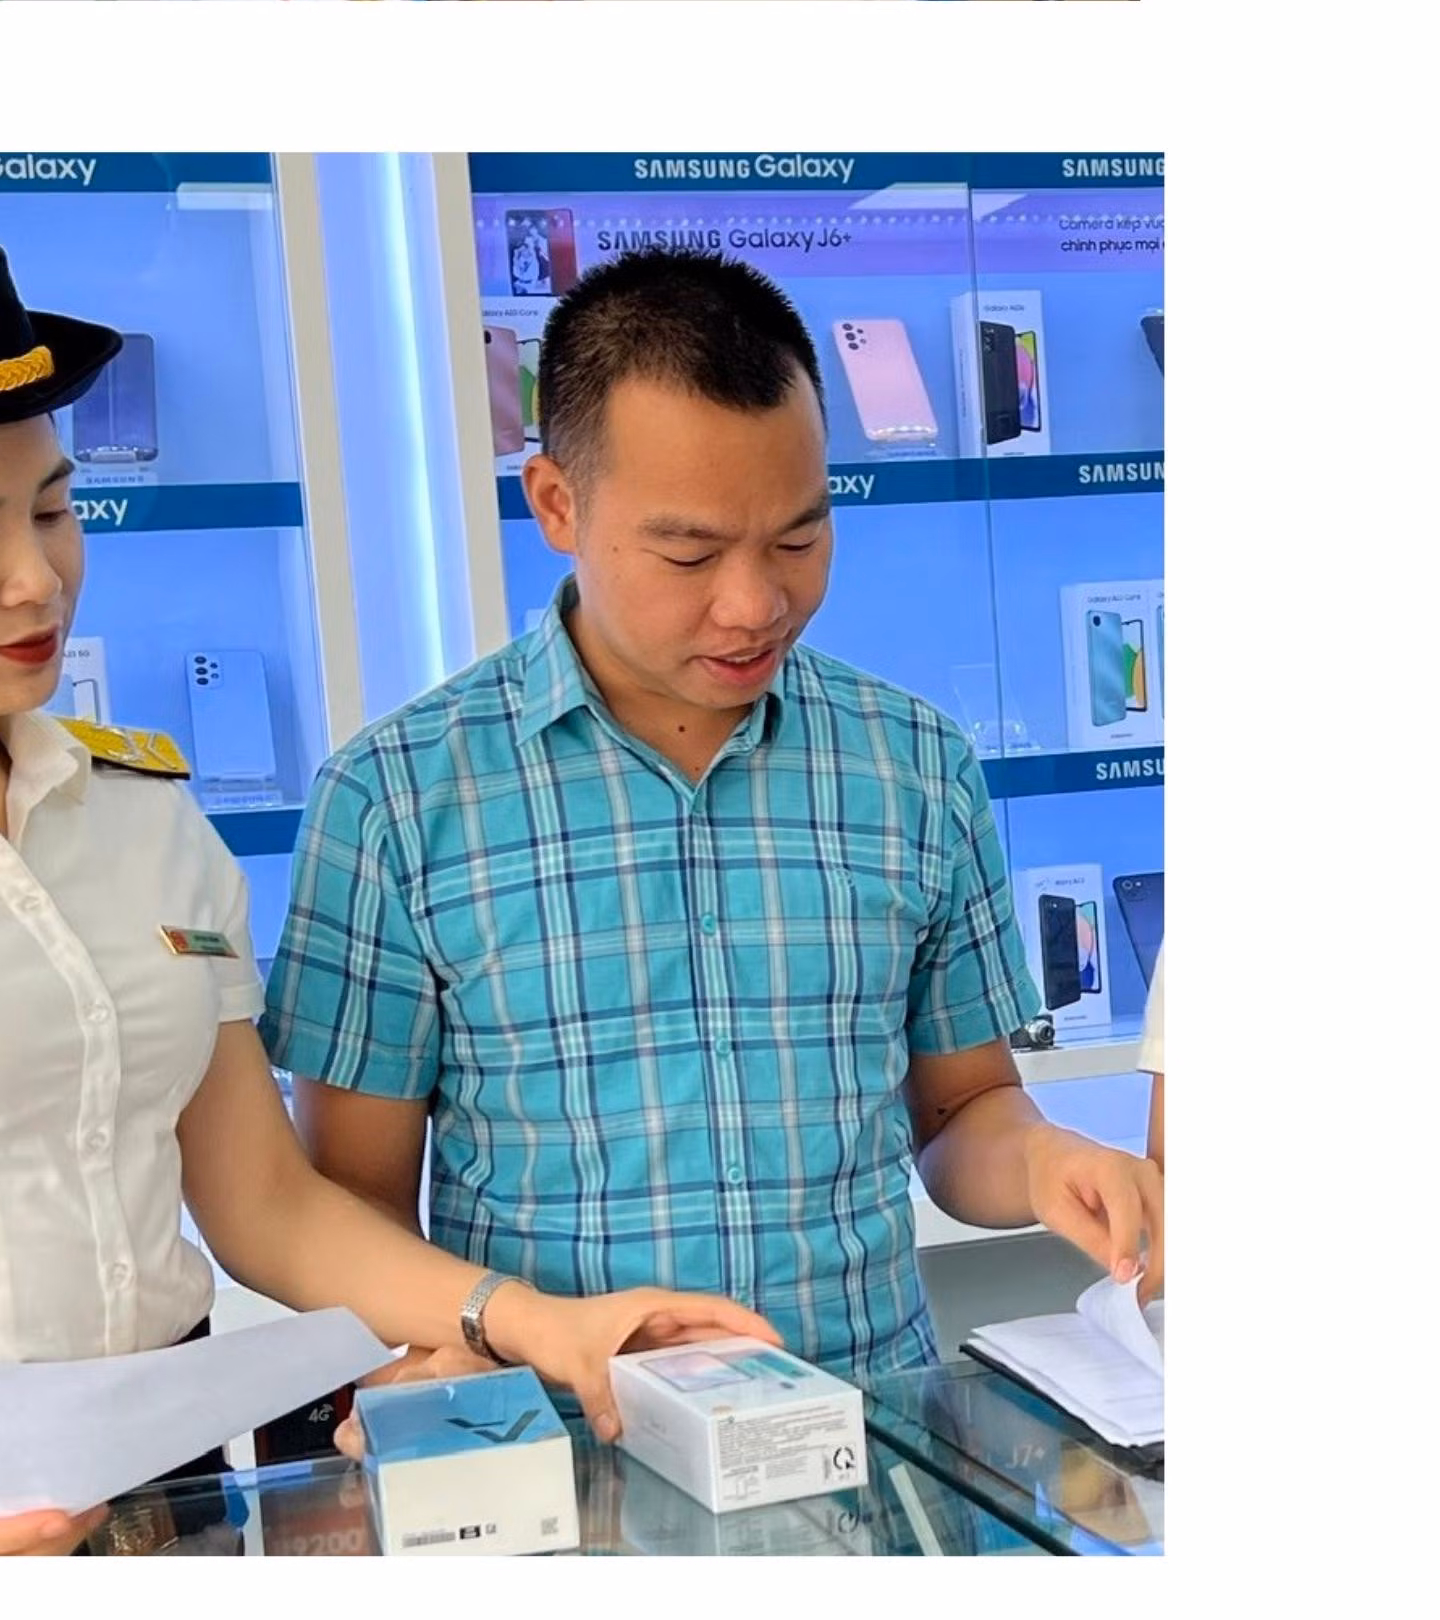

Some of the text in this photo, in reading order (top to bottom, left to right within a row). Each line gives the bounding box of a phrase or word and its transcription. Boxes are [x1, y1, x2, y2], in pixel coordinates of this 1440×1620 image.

[634, 154, 855, 184] SAMSUNG Galaxy
[597, 228, 853, 253] SAMSUNG Galaxy J6+
[828, 473, 875, 499] axy
[71, 498, 128, 526] axy
